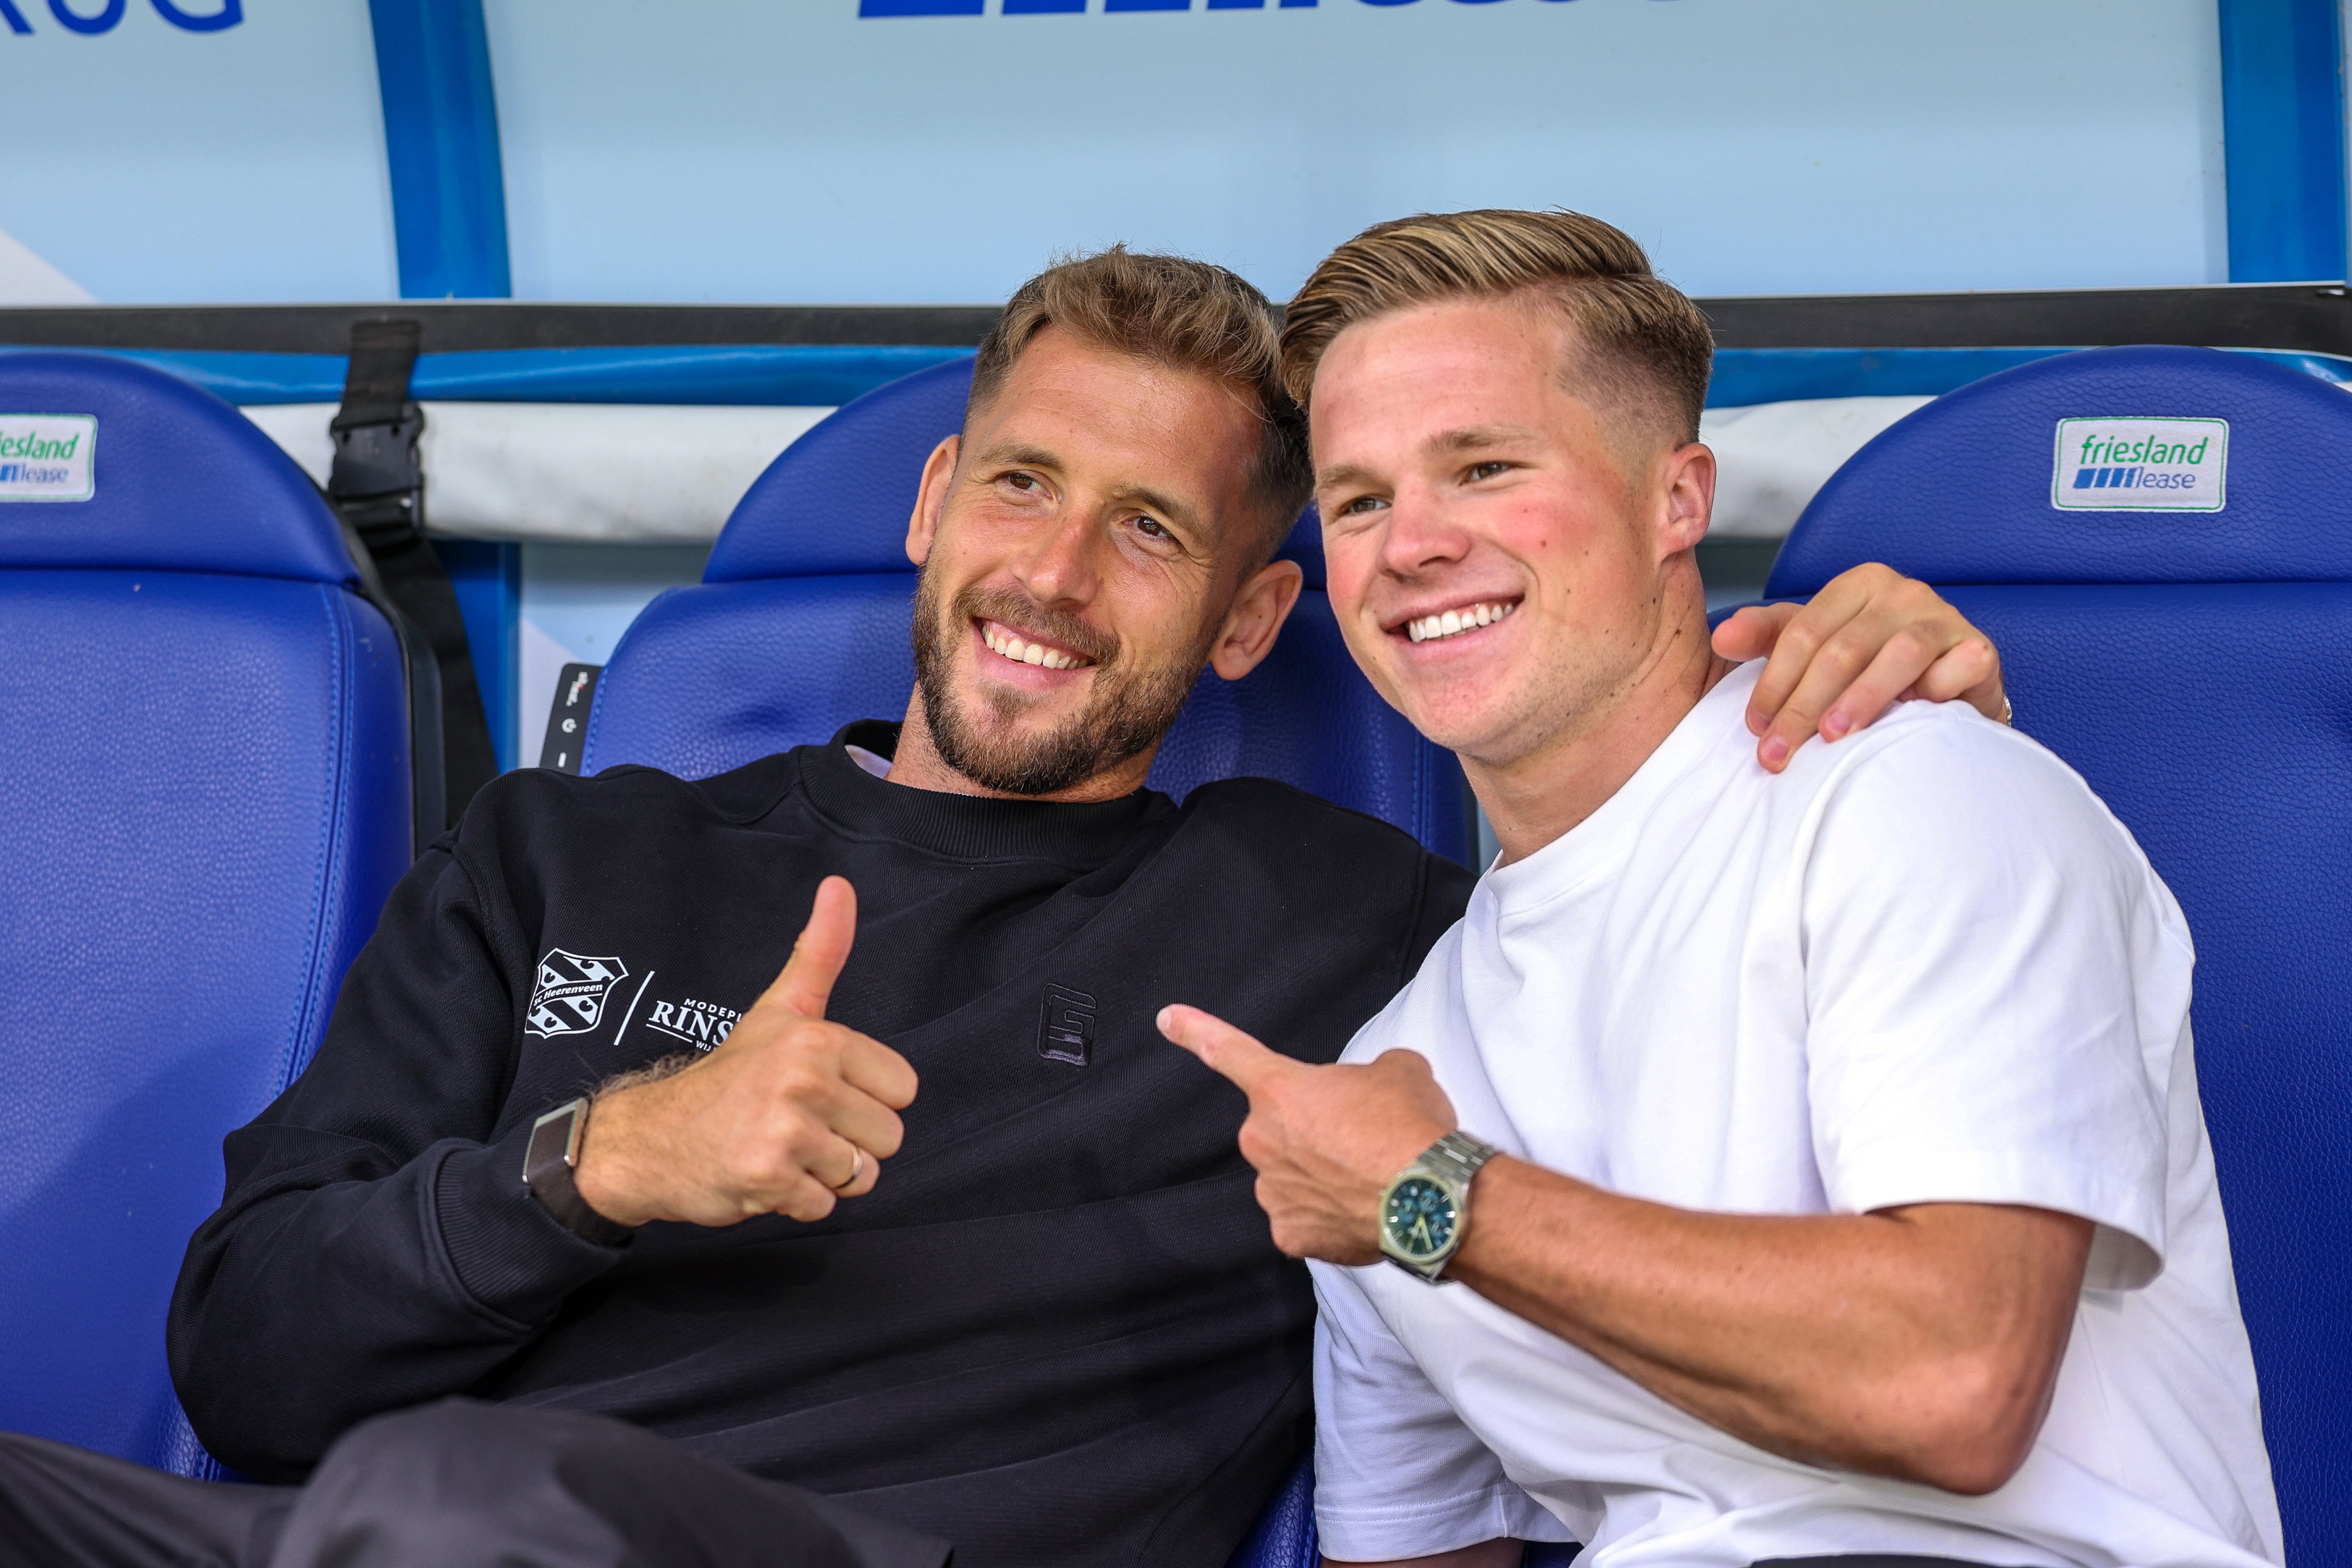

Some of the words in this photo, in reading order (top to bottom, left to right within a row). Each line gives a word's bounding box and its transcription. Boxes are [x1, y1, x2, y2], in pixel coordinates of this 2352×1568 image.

[0, 432, 80, 459] esland
[2081, 435, 2209, 465] friesland
[21, 463, 69, 483] lease
[2136, 467, 2196, 488] lease
[543, 984, 603, 1000] Heerenveen
[696, 1040, 711, 1051] WIJ
